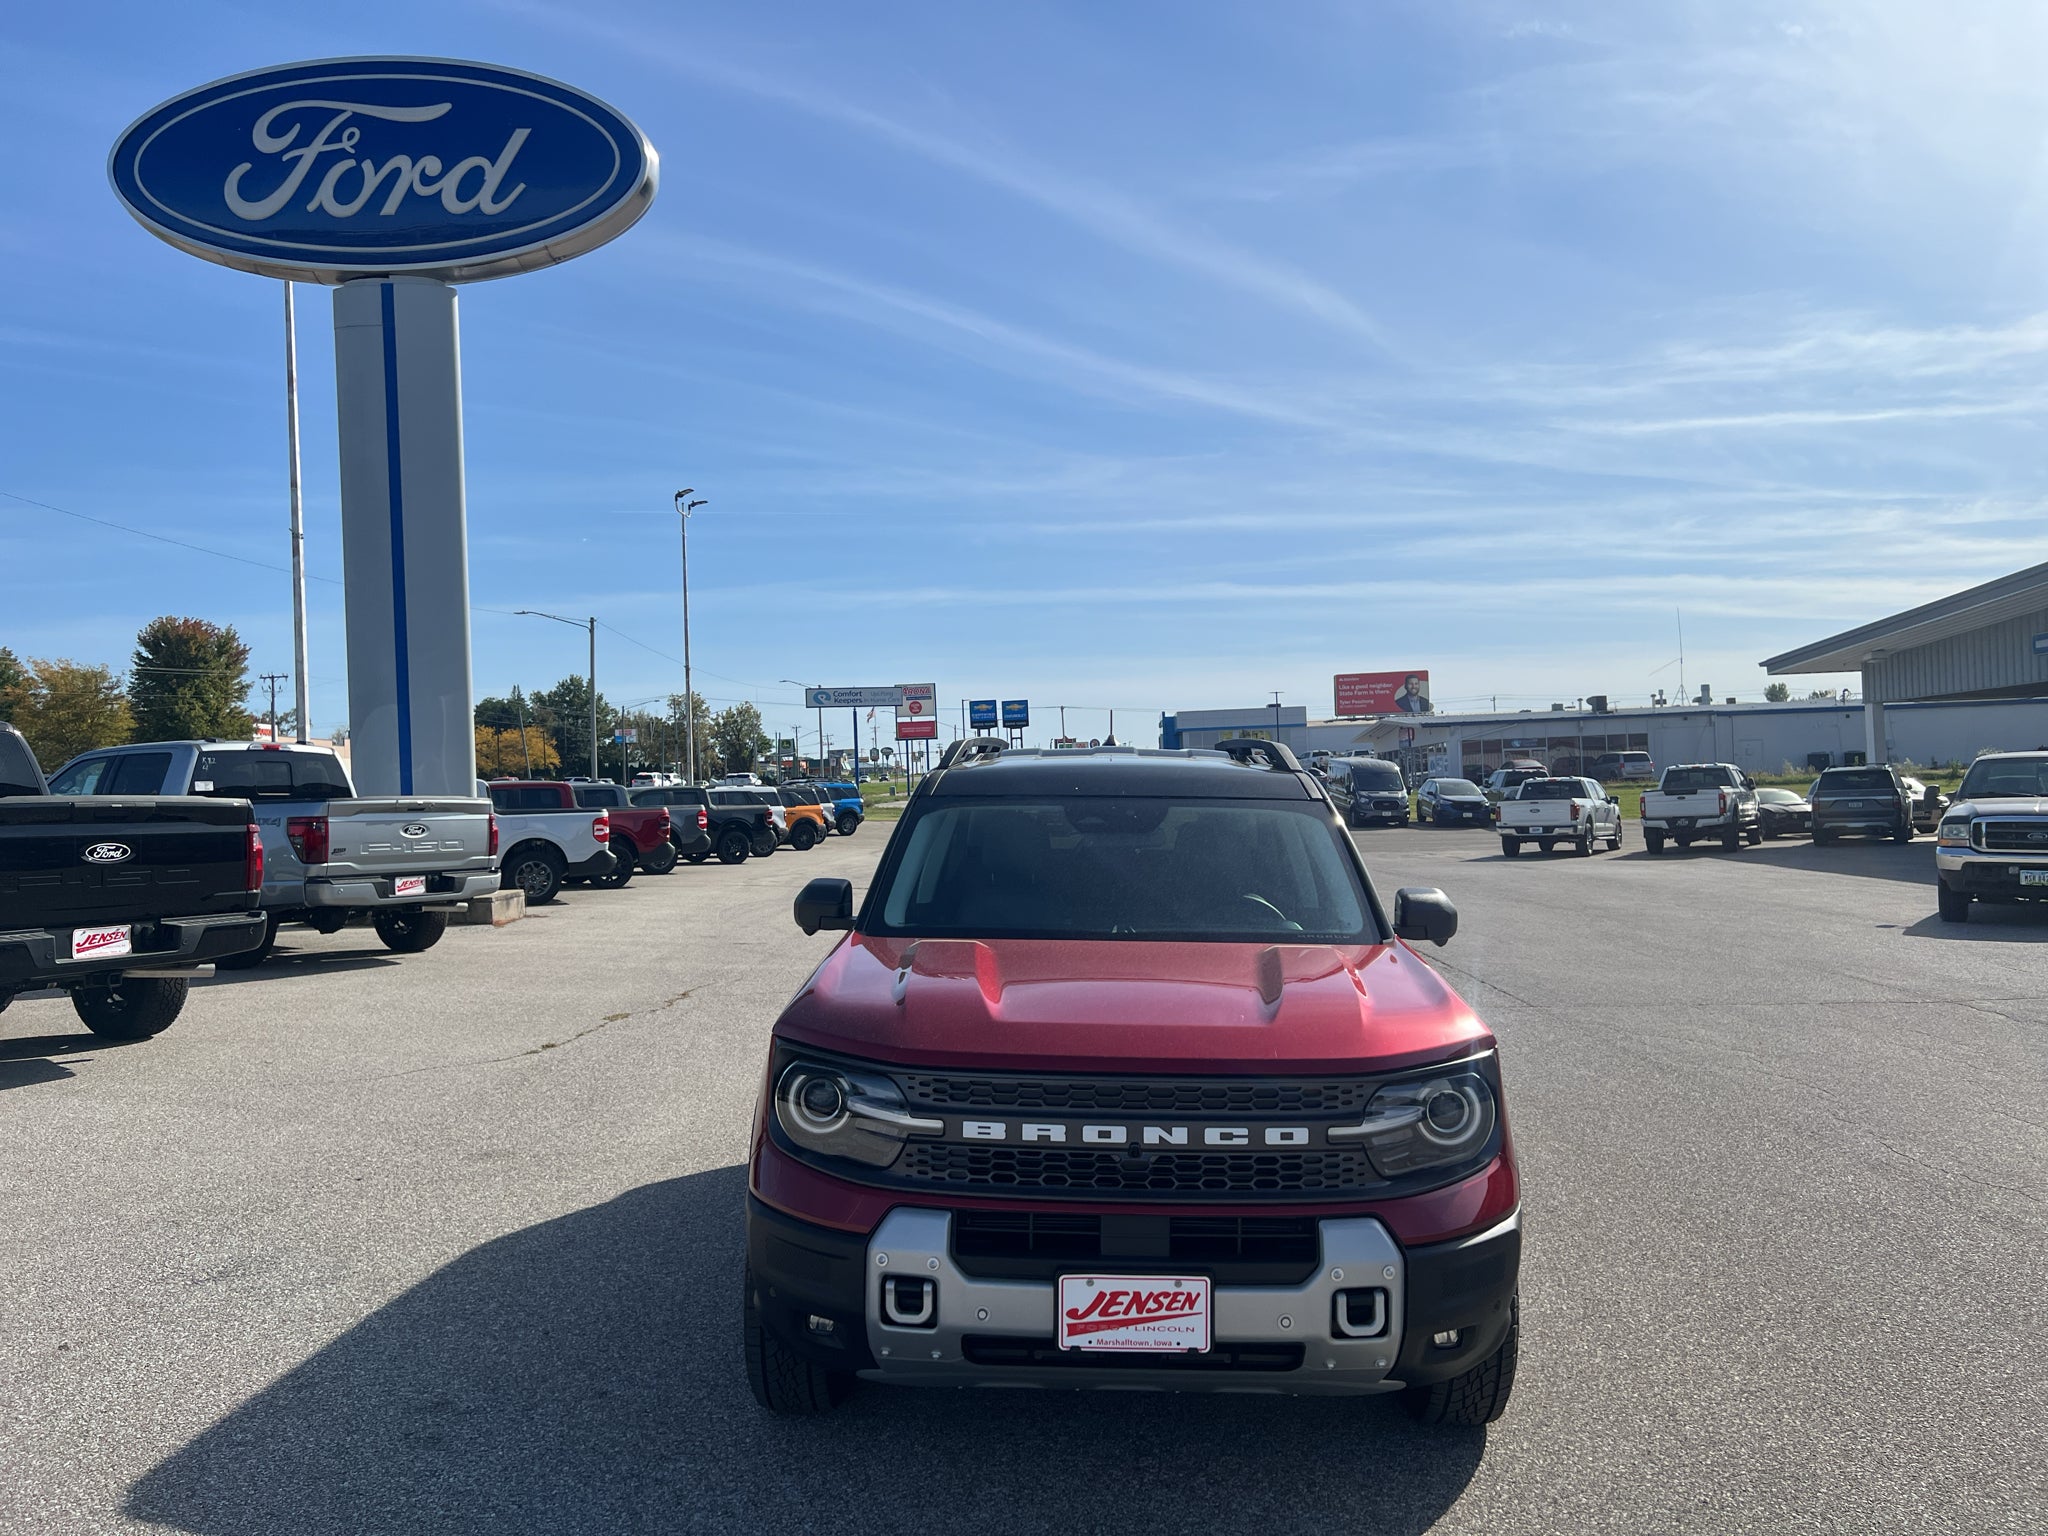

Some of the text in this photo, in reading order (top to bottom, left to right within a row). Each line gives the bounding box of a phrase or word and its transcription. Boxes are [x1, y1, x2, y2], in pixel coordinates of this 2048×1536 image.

[224, 100, 532, 221] Ford
[406, 825, 423, 835] Ford
[93, 845, 123, 858] Ford
[360, 839, 465, 856] F-150
[75, 930, 127, 948] JENSEN
[962, 1121, 1309, 1145] BRONCO
[1066, 1290, 1201, 1320] JENSEN
[1096, 1339, 1152, 1347] Marshalltown,
